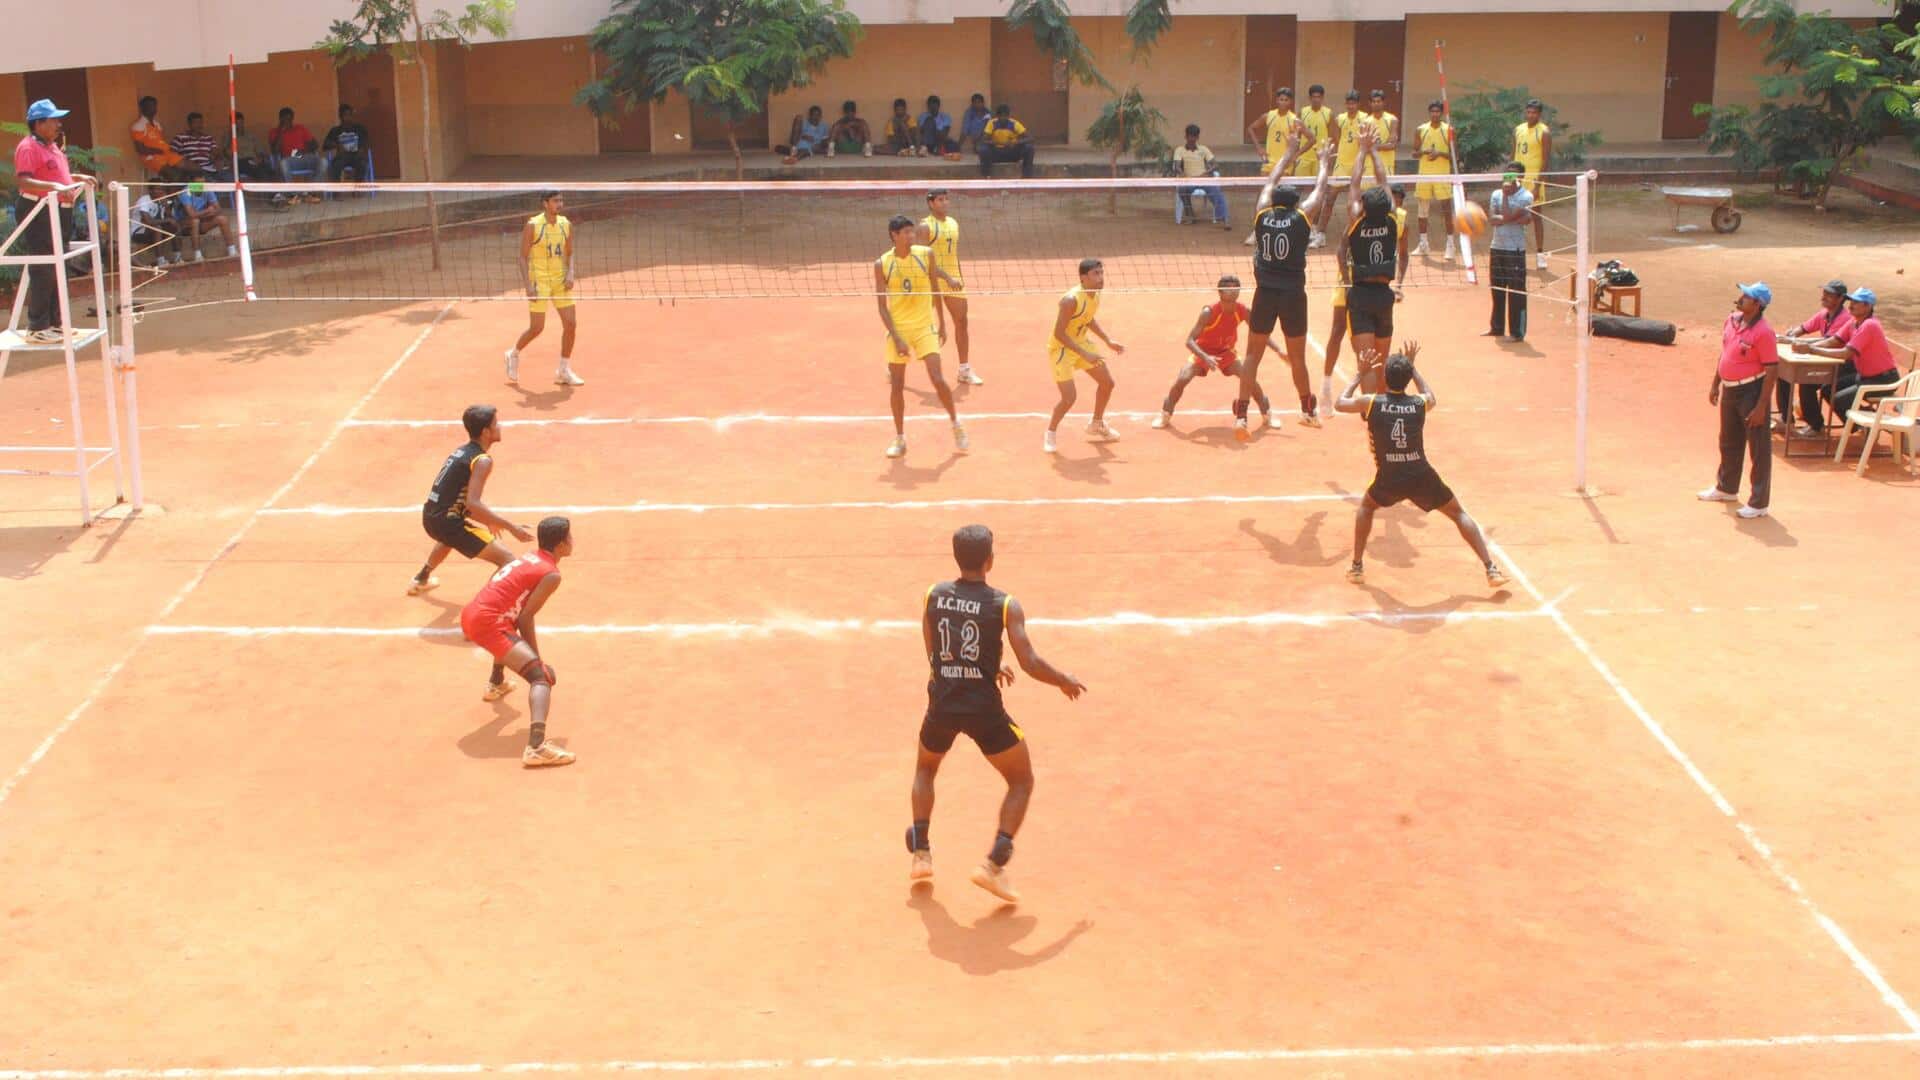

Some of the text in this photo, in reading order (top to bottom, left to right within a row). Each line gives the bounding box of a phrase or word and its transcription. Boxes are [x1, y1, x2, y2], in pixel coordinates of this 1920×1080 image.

[1275, 130, 1281, 143] 2
[547, 243, 562, 257] 14
[946, 237, 952, 254] 7
[1262, 233, 1289, 261] 10
[1369, 241, 1384, 265] 6
[903, 278, 912, 293] 9
[1391, 418, 1407, 448] 4
[937, 596, 980, 614] K.C.TECH
[938, 618, 980, 661] 12
[963, 666, 983, 679] BALL
